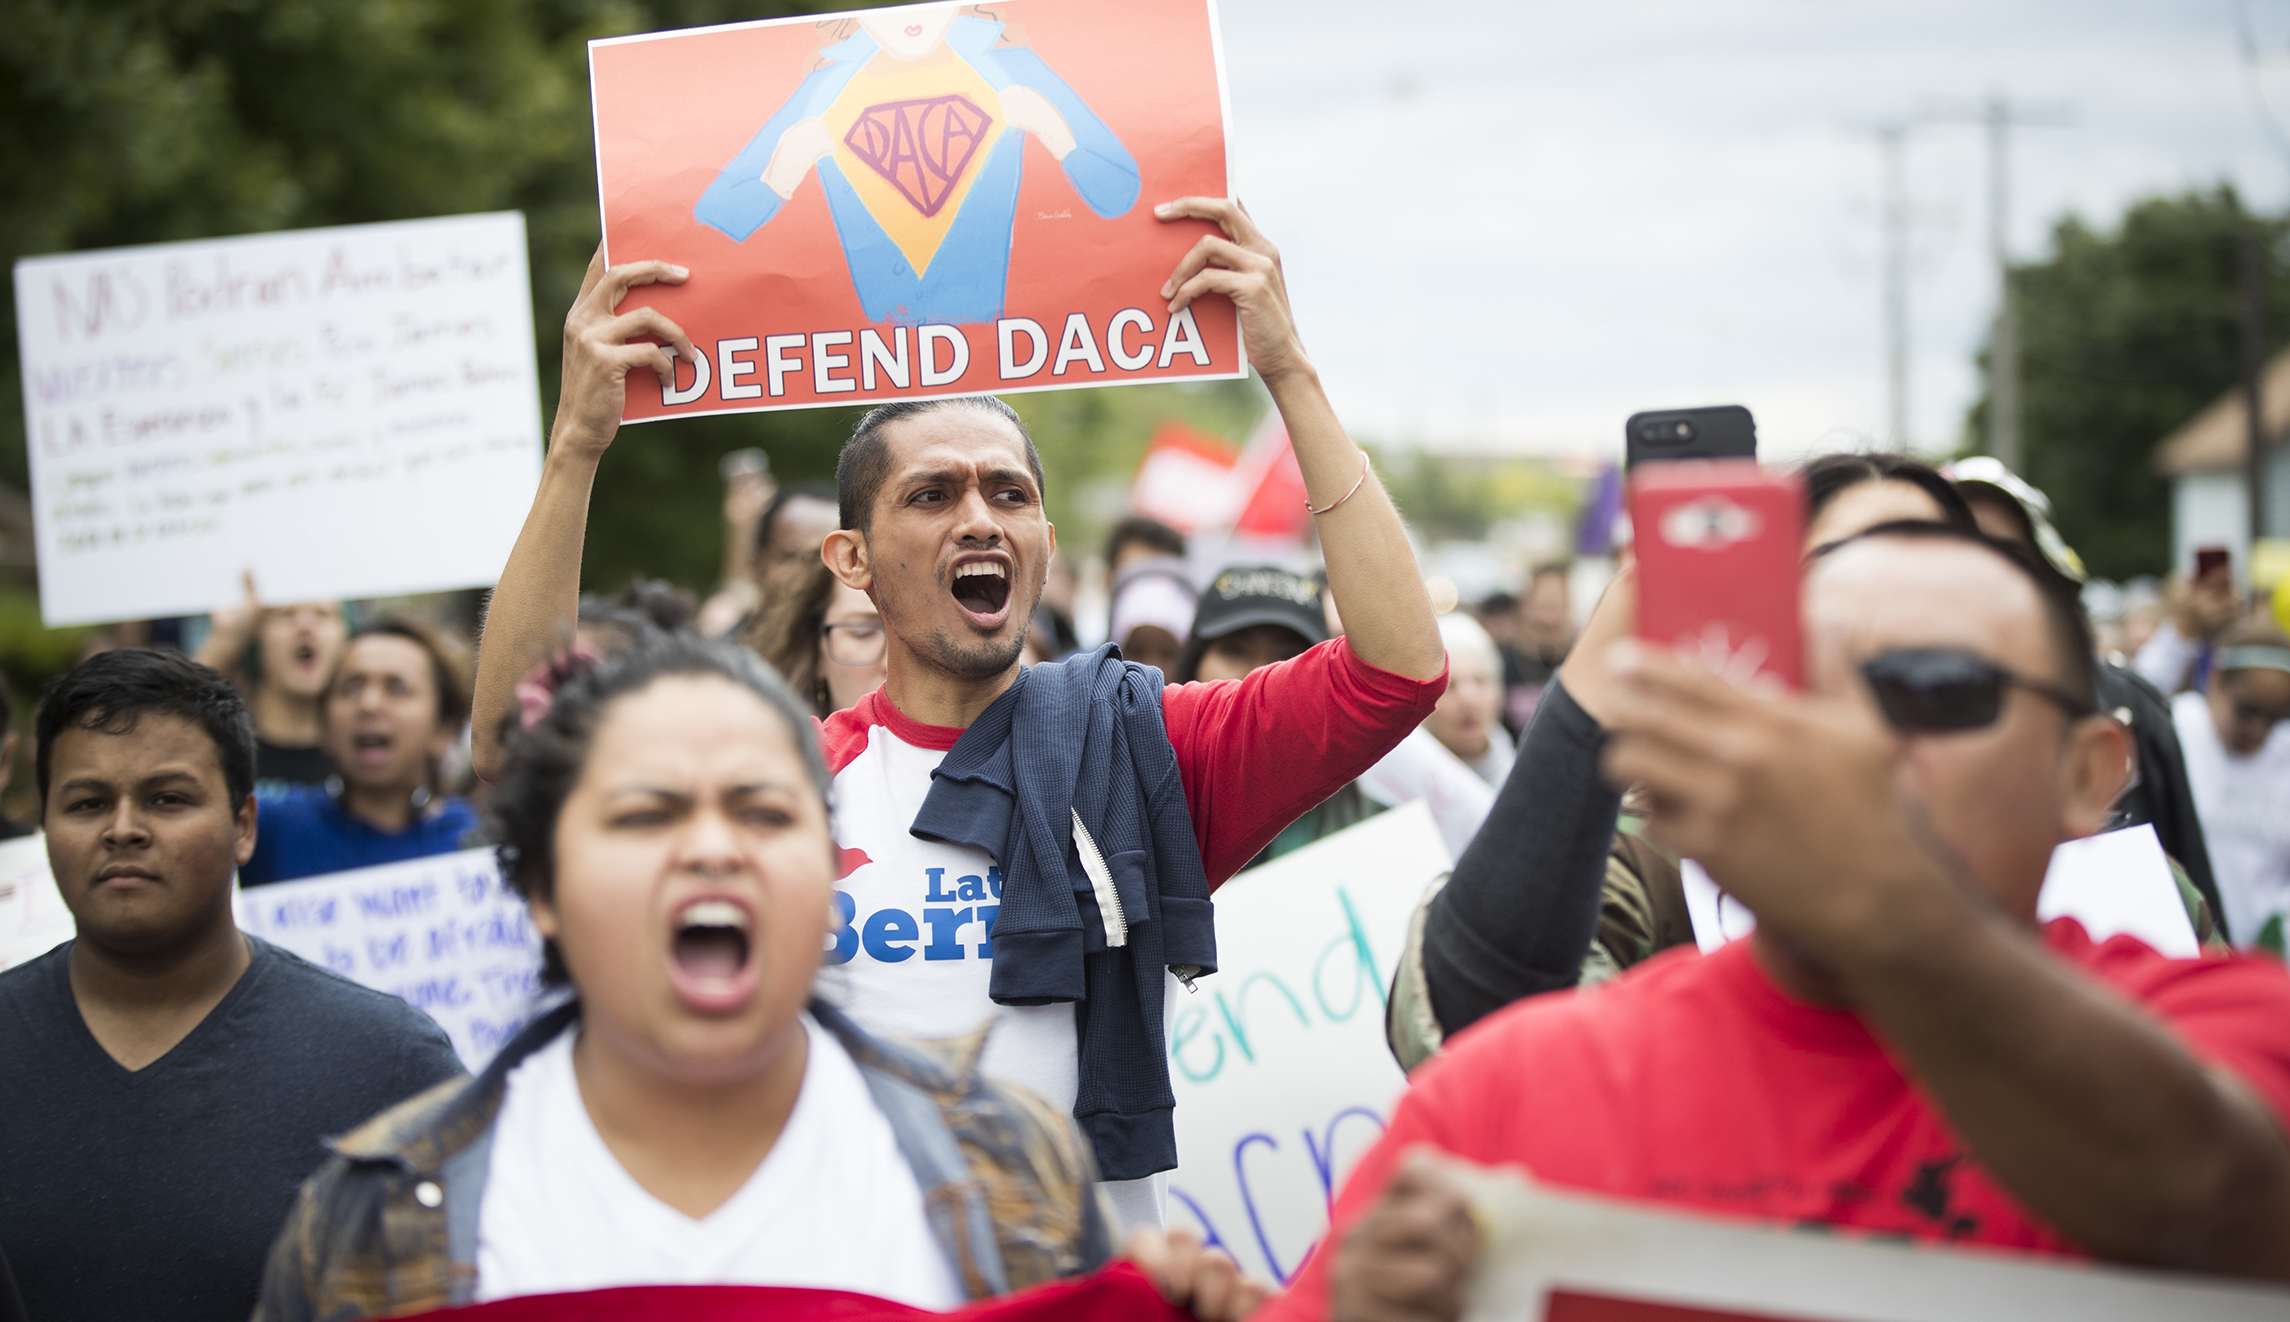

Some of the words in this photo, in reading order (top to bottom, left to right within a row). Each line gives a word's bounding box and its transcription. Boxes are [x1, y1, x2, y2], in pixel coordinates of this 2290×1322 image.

[859, 103, 976, 209] DACA
[661, 324, 971, 407] DEFEND
[998, 304, 1211, 380] DACA
[925, 867, 1001, 903] Lat
[1171, 884, 1389, 1084] end
